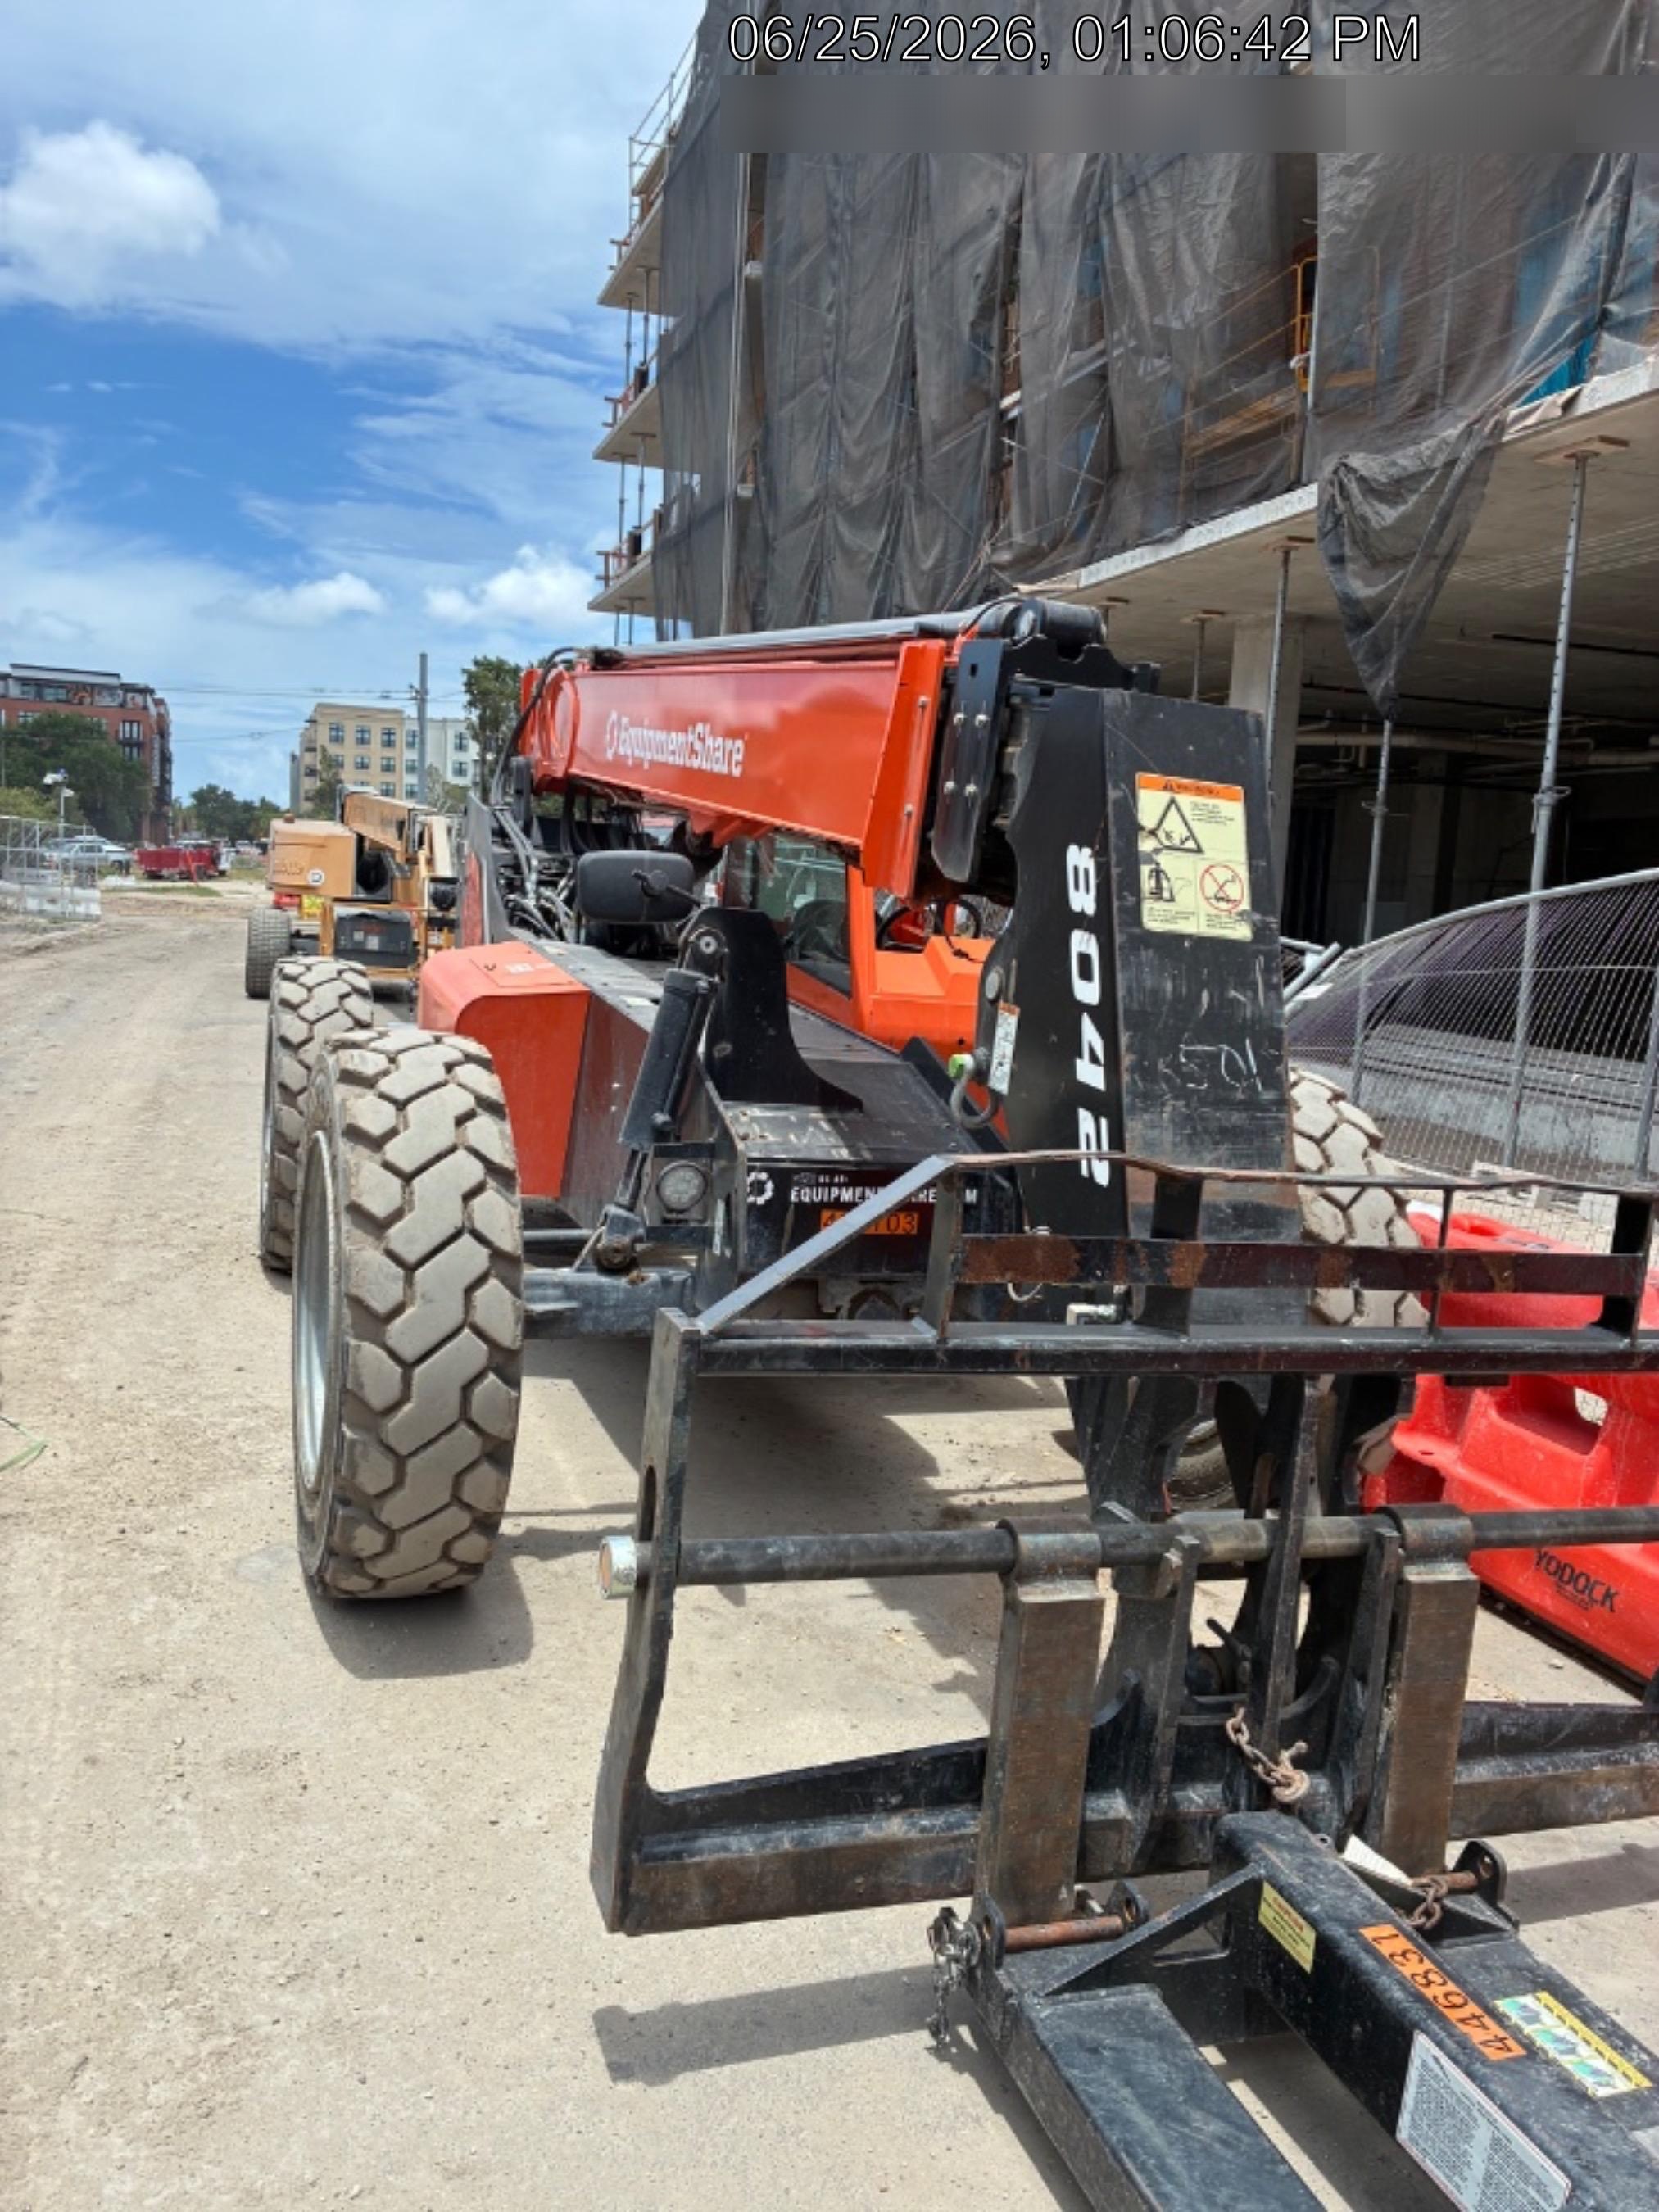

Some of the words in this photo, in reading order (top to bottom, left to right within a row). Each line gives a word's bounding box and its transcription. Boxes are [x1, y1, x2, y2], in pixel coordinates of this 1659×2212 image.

[618, 716, 745, 777] EquipmentShare
[1066, 843, 1110, 1188] 8042
[1535, 1548, 1619, 1612] YODOCK
[1371, 1933, 1514, 2053] 446831
